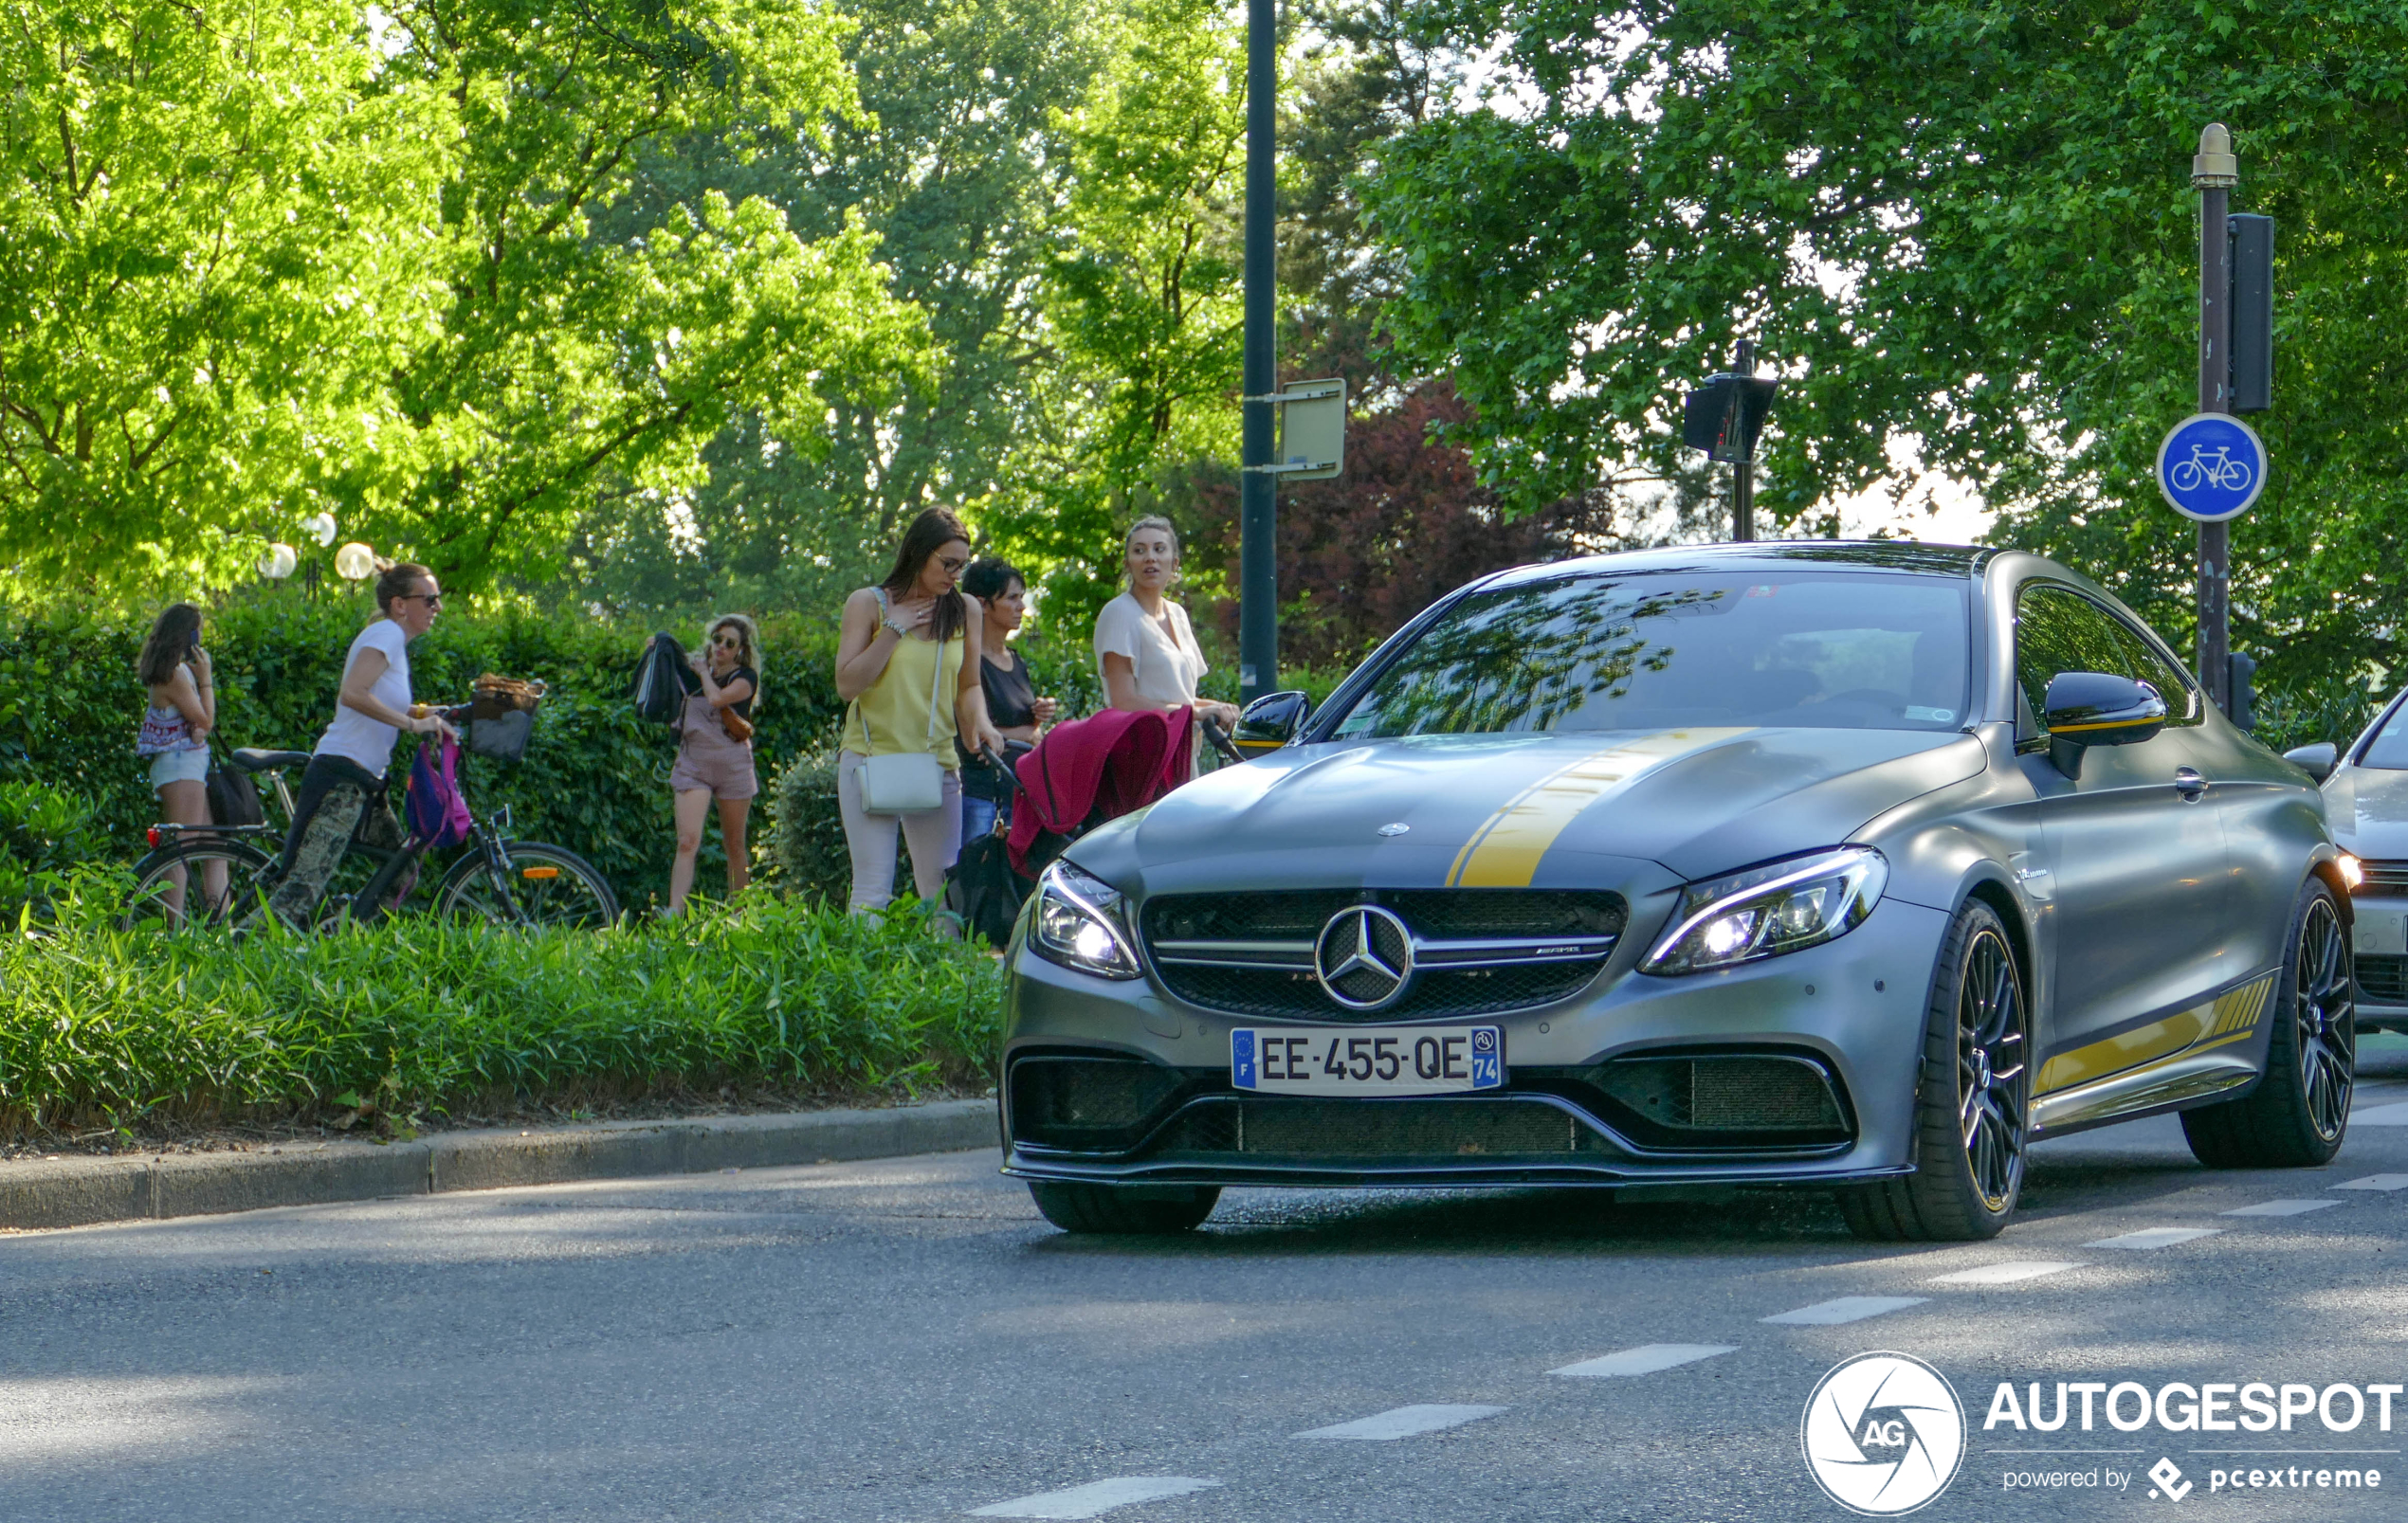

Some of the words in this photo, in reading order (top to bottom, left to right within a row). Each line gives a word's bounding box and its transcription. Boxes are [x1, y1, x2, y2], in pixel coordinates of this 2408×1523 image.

[1262, 1036, 1469, 1081] EE-455-QE
[1240, 1063, 1248, 1077] F
[1474, 1059, 1497, 1079] 74
